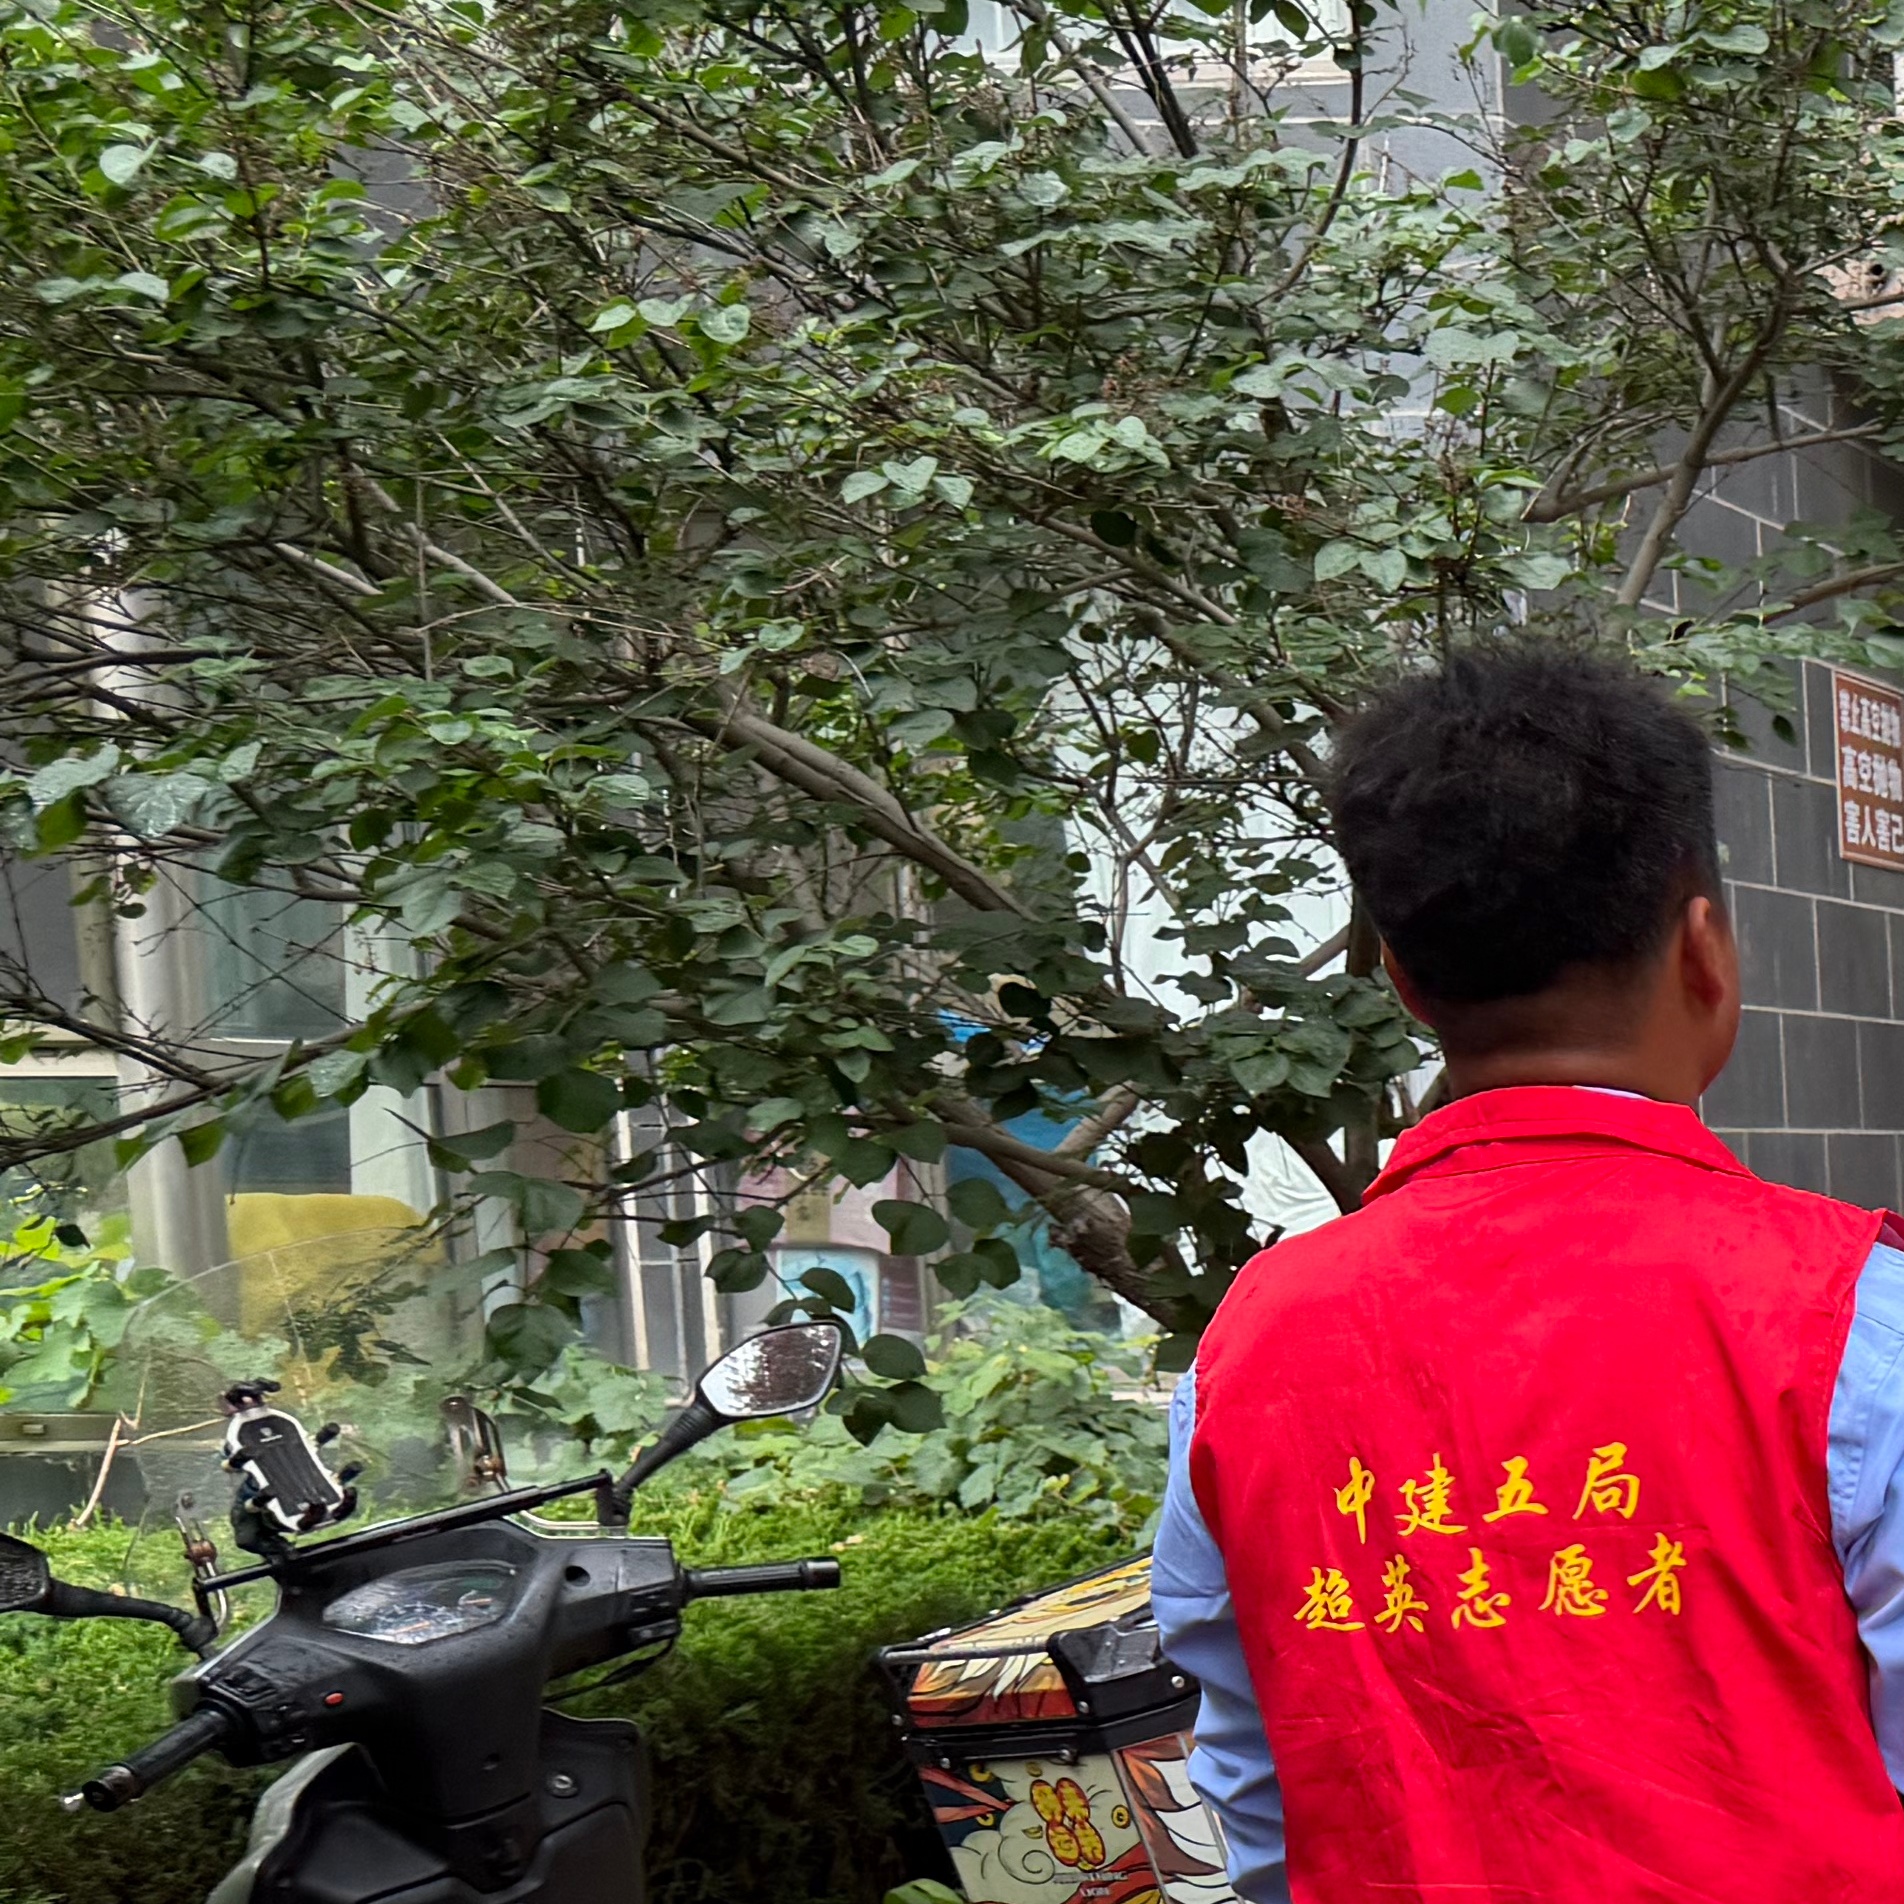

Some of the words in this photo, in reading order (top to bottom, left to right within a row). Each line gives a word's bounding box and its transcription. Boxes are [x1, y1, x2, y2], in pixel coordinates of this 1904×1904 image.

[1841, 744, 1903, 802] 高空抛物
[1844, 799, 1904, 854] 害人害己
[1332, 1440, 1642, 1545] 中建五局
[1293, 1531, 1689, 1635] 超英志愿者
